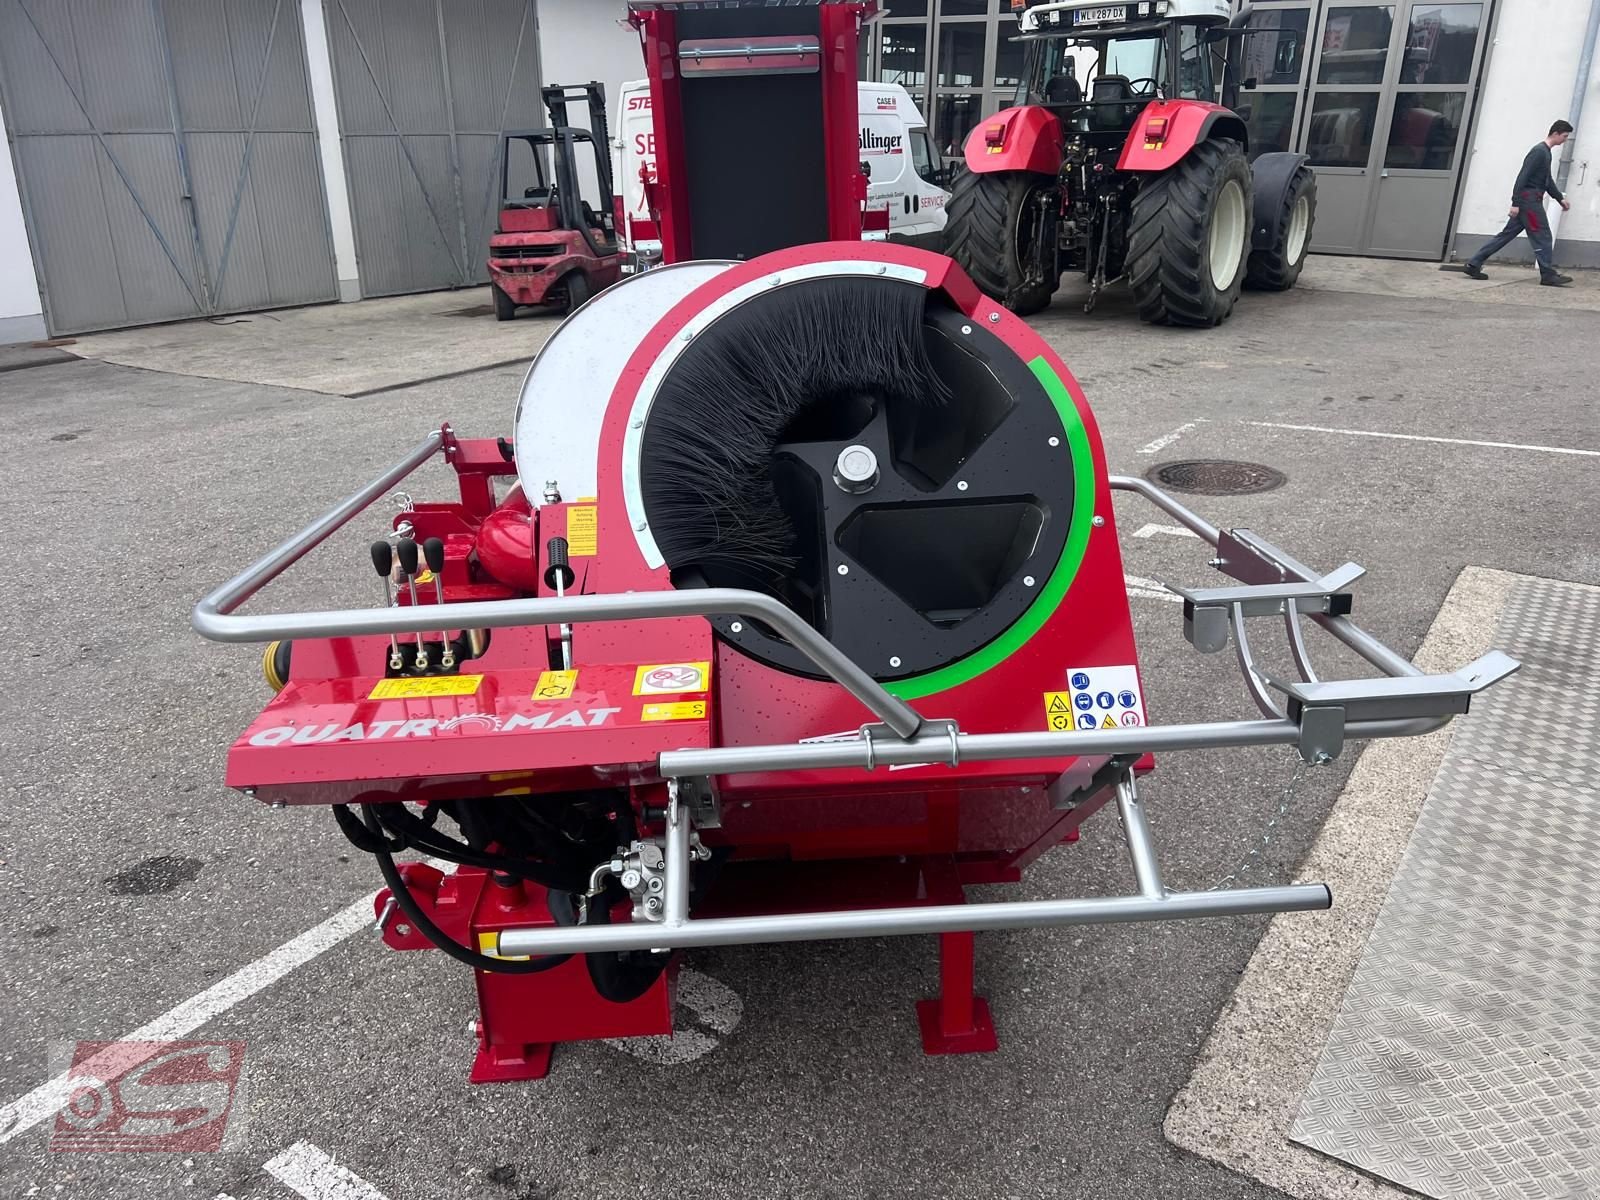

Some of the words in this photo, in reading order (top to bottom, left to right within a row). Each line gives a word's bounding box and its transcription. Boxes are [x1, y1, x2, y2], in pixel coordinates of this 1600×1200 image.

[1081, 10, 1091, 21] WL
[1096, 9, 1112, 20] 287
[1113, 8, 1124, 18] DX
[921, 196, 944, 208] SERVICE
